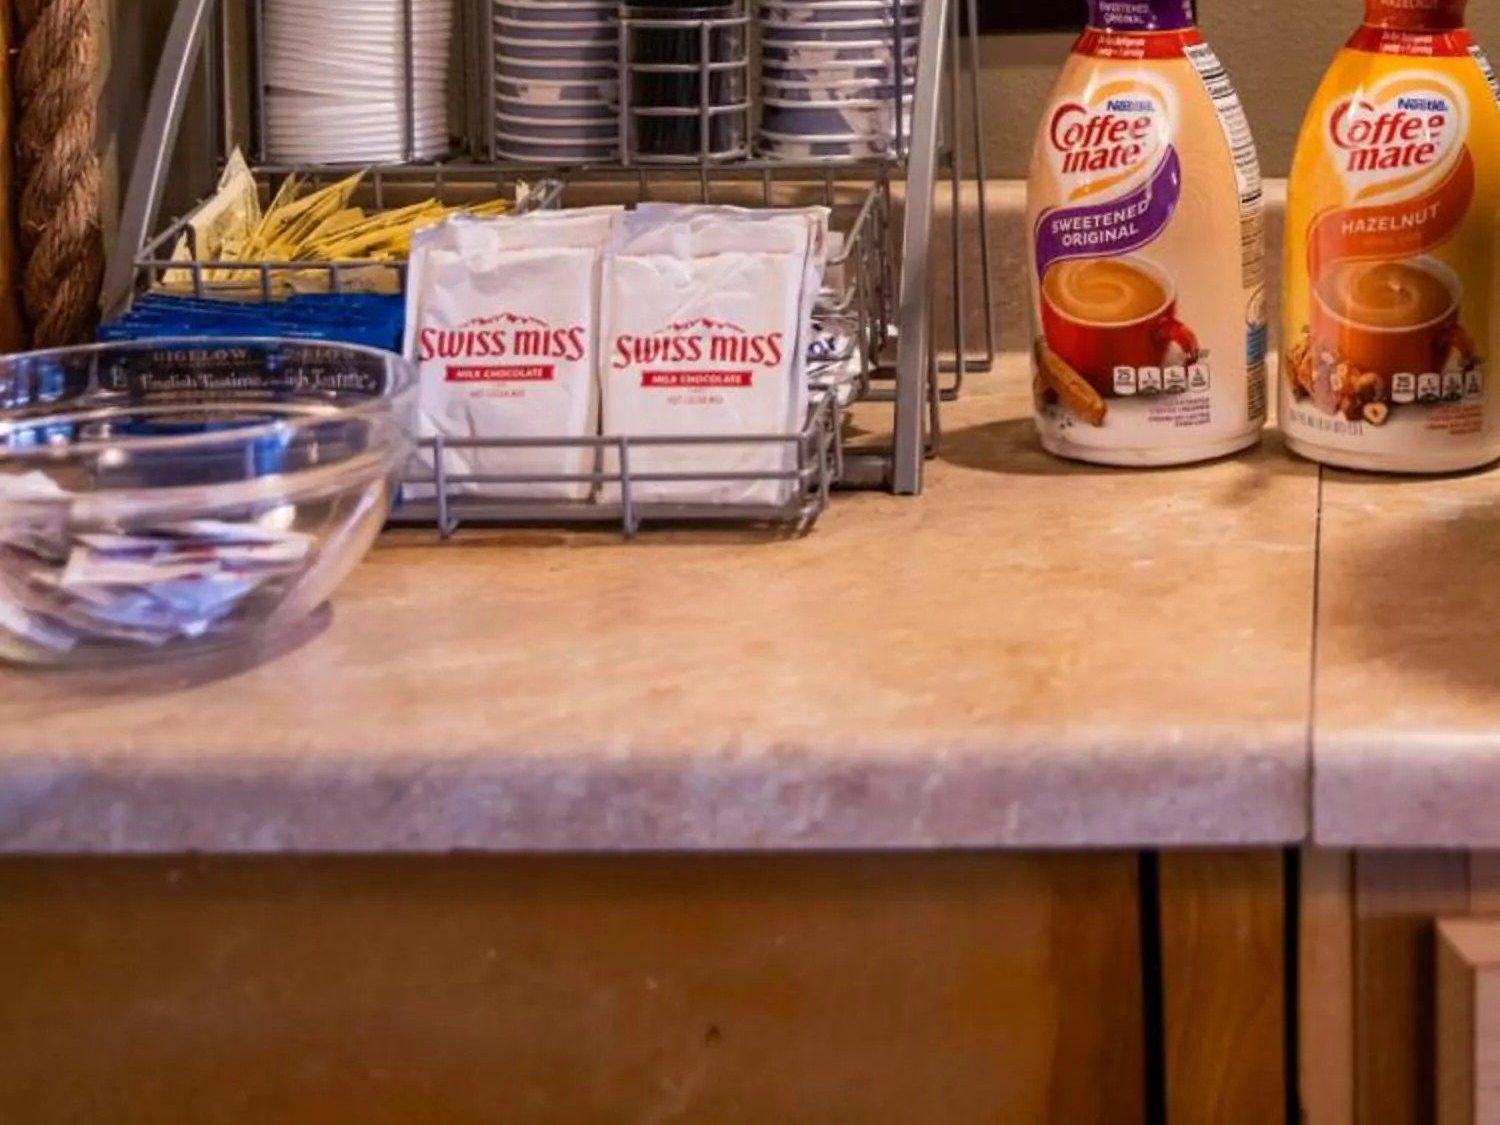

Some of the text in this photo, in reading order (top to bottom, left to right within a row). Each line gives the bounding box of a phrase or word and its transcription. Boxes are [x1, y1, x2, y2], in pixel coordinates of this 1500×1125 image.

[1050, 103, 1151, 153] Coffee
[1330, 98, 1445, 150] Coffee
[1062, 142, 1141, 173] mate
[1346, 142, 1435, 172] mate
[1051, 199, 1150, 234] SWEETENED
[1341, 202, 1440, 236] HAZELNUT
[1062, 223, 1140, 247] ORIGINAL
[456, 367, 544, 379] MILK CHOCOLATE
[652, 375, 742, 385] MILK CHOCOLATE
